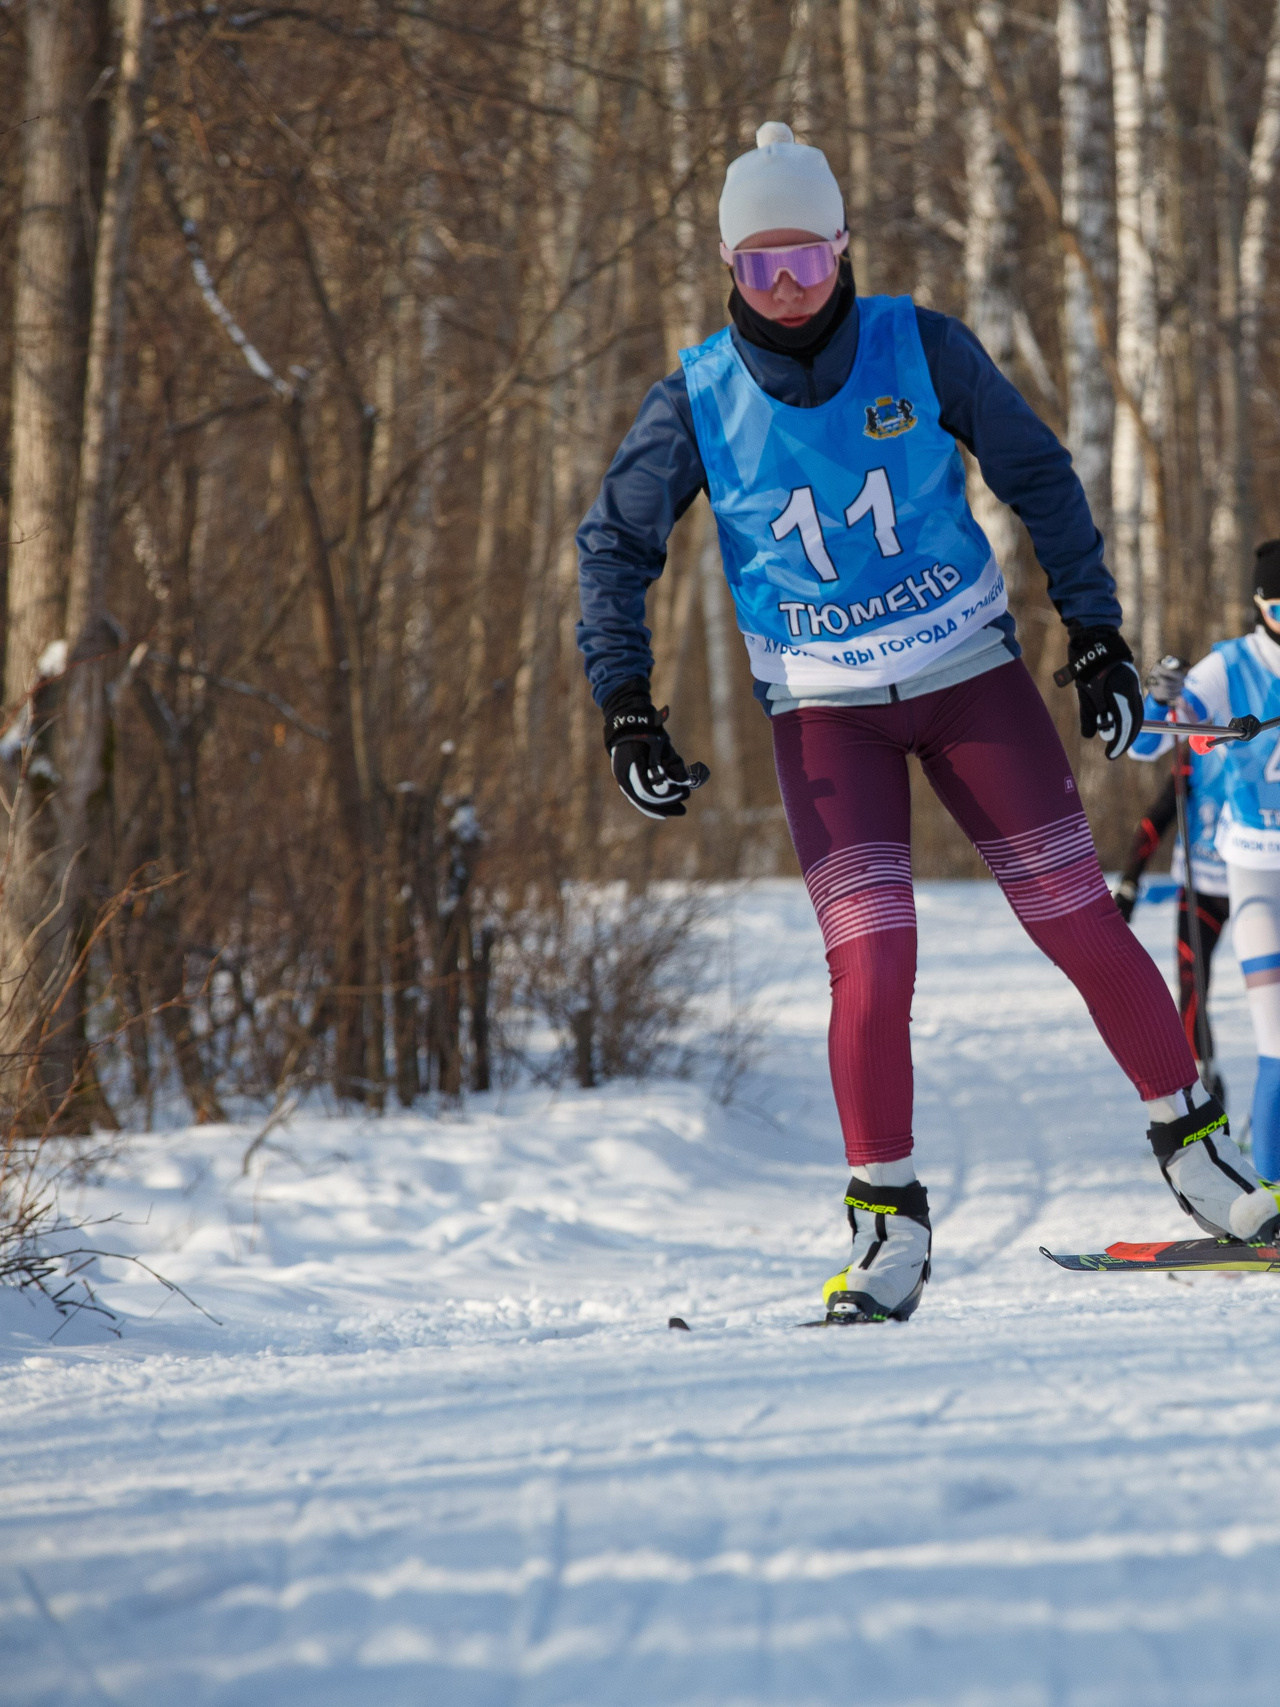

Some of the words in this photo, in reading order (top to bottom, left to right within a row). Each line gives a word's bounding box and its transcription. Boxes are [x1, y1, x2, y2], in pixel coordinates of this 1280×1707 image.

[770, 466, 903, 583] 11
[779, 563, 962, 637] ТЮМЕНЬ
[878, 618, 958, 656] ГОРОДА
[1183, 1113, 1229, 1147] FISCHE
[844, 1195, 898, 1215] SCHER
